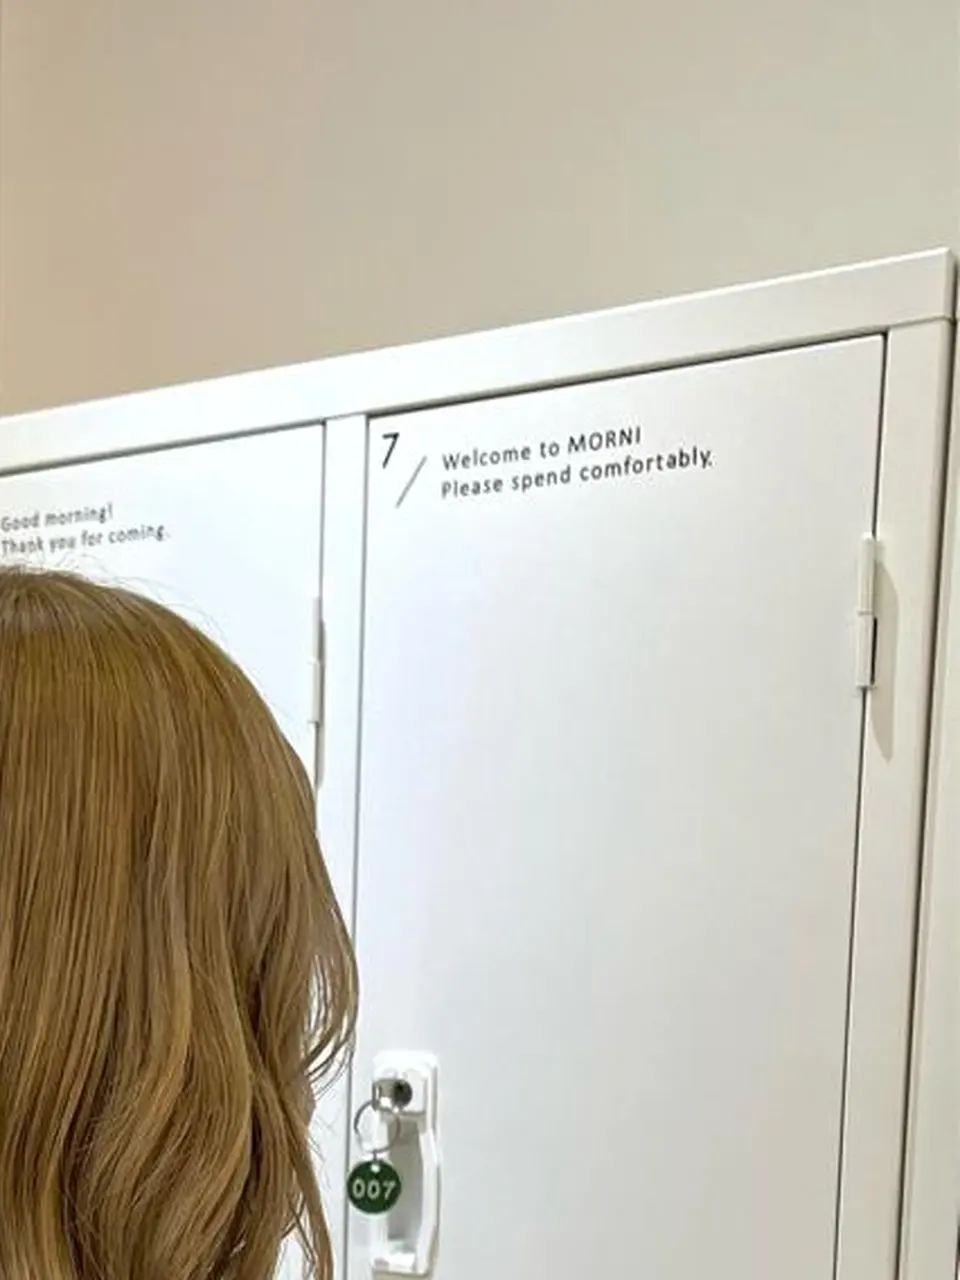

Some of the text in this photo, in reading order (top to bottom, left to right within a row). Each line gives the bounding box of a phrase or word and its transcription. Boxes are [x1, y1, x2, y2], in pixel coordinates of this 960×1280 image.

[382, 431, 400, 469] 7
[442, 425, 641, 471] Welcome to MORNI
[442, 445, 714, 499] Please spend comfortably.
[0, 502, 114, 532] Good morning!
[0, 536, 44, 556] Thank
[49, 537, 76, 553] you
[80, 529, 103, 546] for
[351, 1178, 396, 1199] 007
